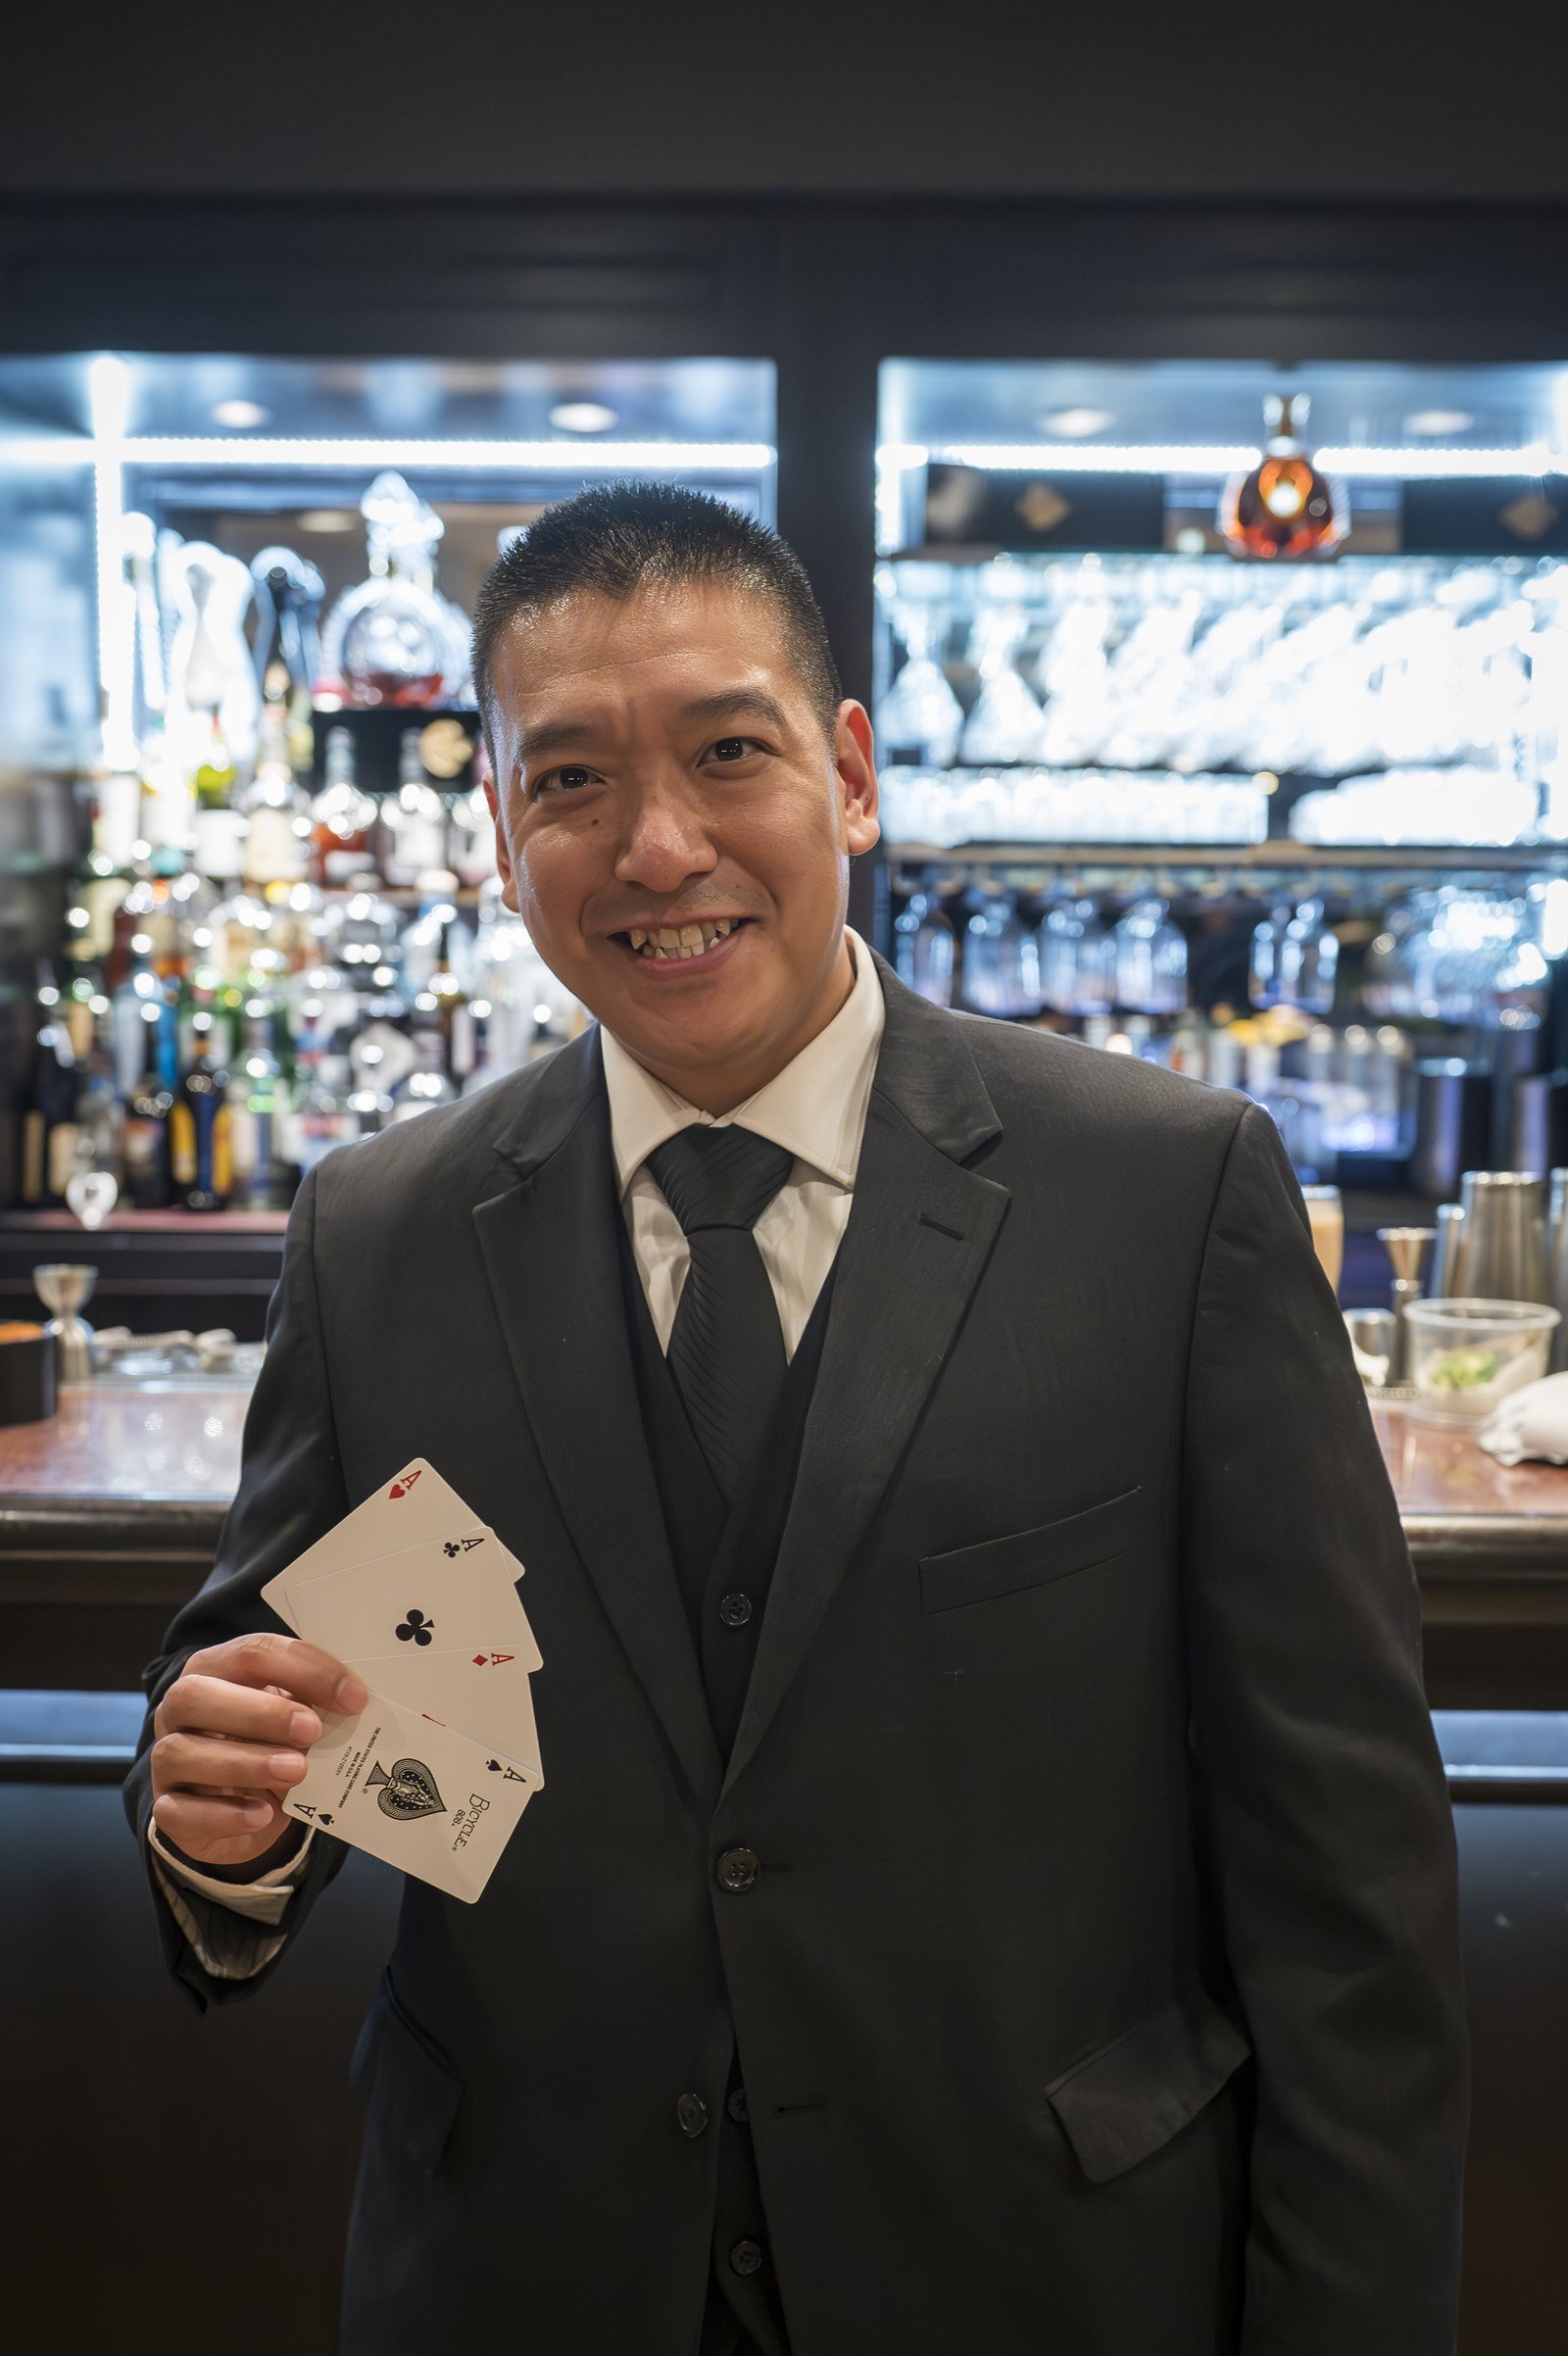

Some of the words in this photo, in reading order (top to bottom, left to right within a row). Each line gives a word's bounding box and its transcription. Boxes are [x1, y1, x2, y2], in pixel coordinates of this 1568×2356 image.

[400, 1470, 422, 1491] A
[461, 1538, 485, 1552] A
[491, 1652, 515, 1667] A
[367, 1735, 377, 1749] UNITED
[353, 1751, 362, 1763] MADE
[360, 1748, 370, 1763] STATES
[352, 1762, 364, 1779] PLAYING
[503, 1766, 527, 1784] A
[346, 1779, 356, 1791] CARD
[337, 1790, 350, 1809] COMPANY
[293, 1803, 318, 1819] A
